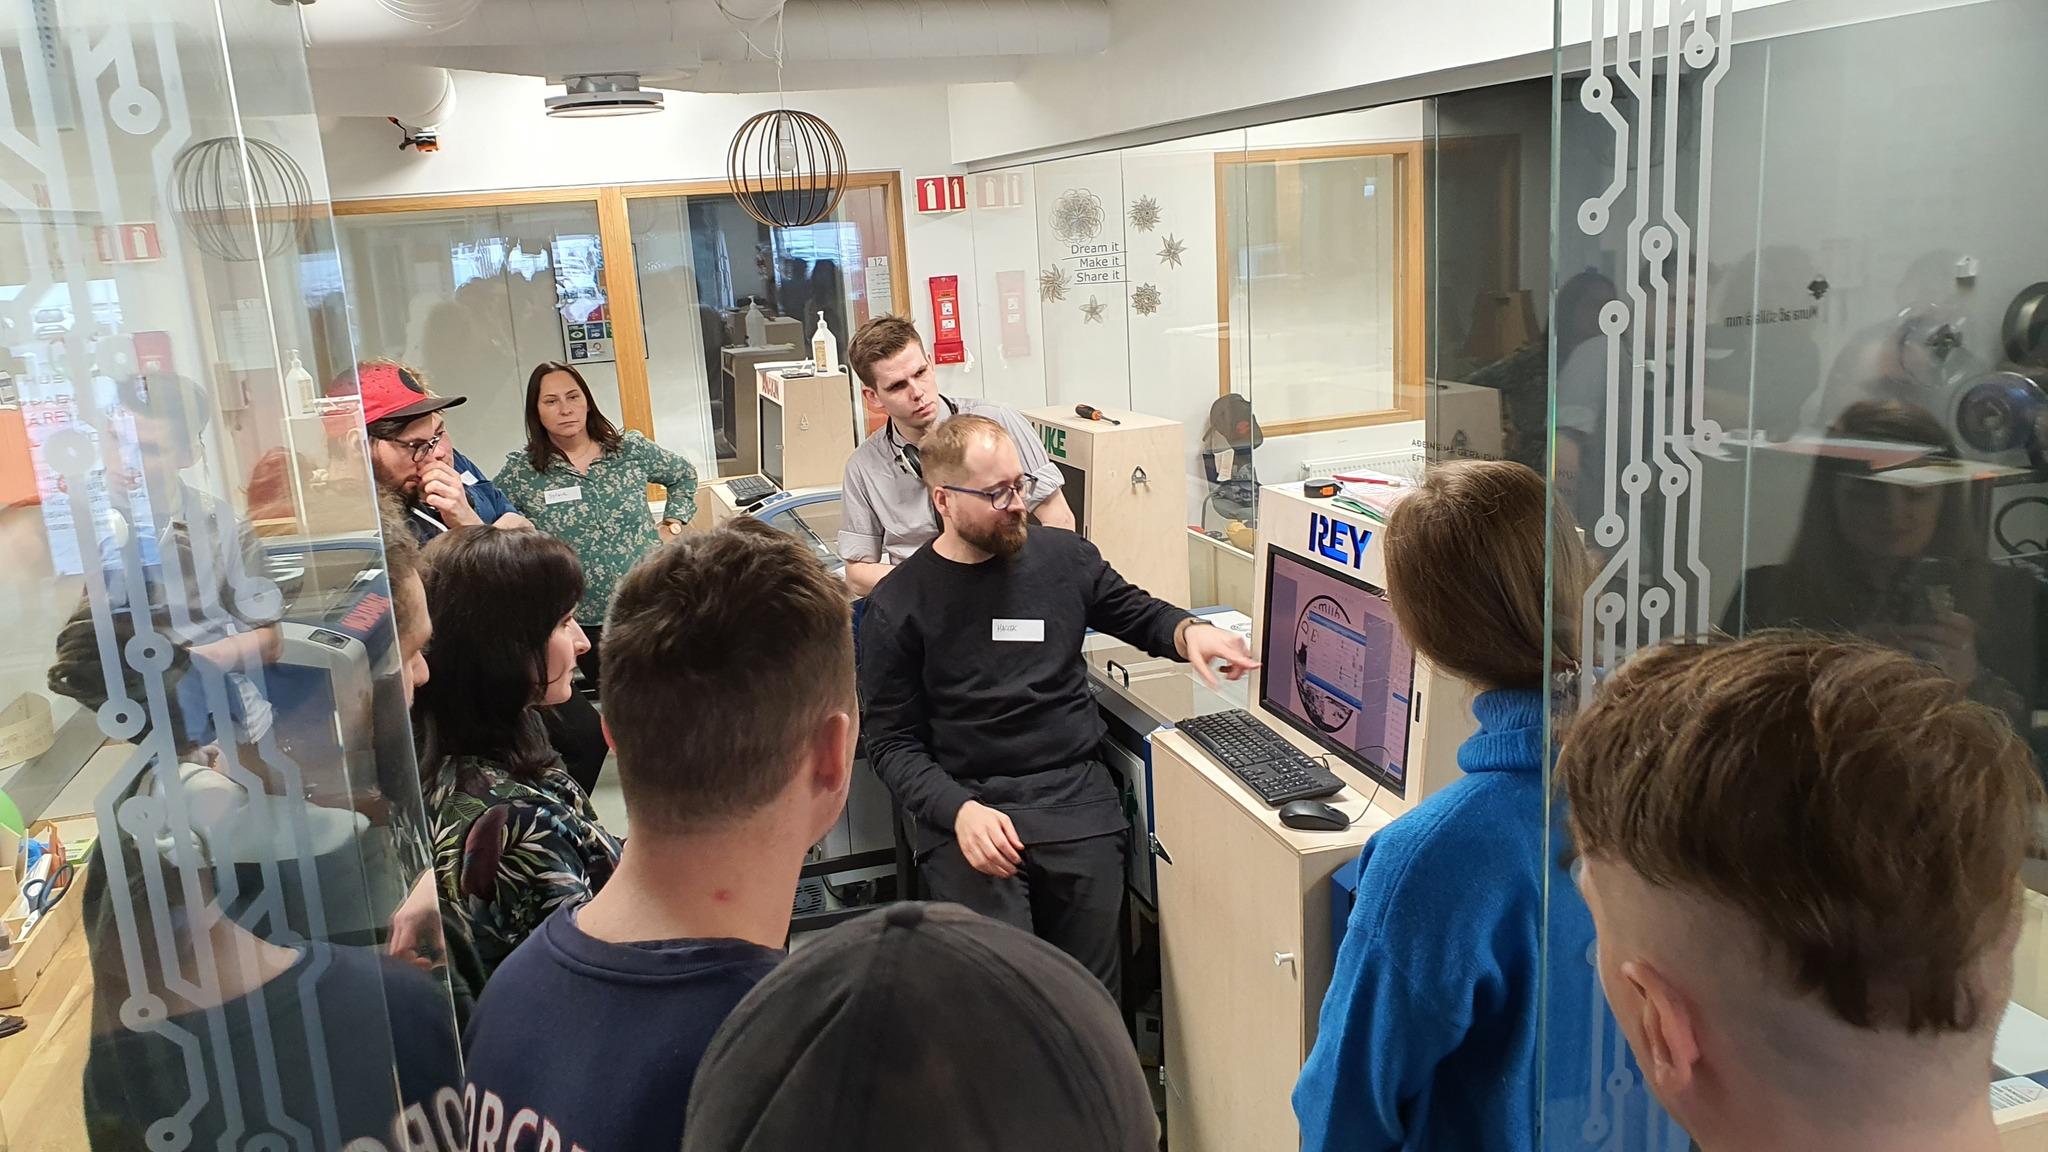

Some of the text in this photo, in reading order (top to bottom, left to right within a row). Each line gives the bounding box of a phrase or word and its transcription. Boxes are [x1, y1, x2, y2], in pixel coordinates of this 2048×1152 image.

[1071, 242, 1119, 254] Dream it
[873, 257, 883, 266] 12
[1080, 256, 1119, 268] Make it
[1076, 270, 1120, 282] Share it
[1032, 422, 1066, 458] UKE
[1308, 511, 1373, 570] REY
